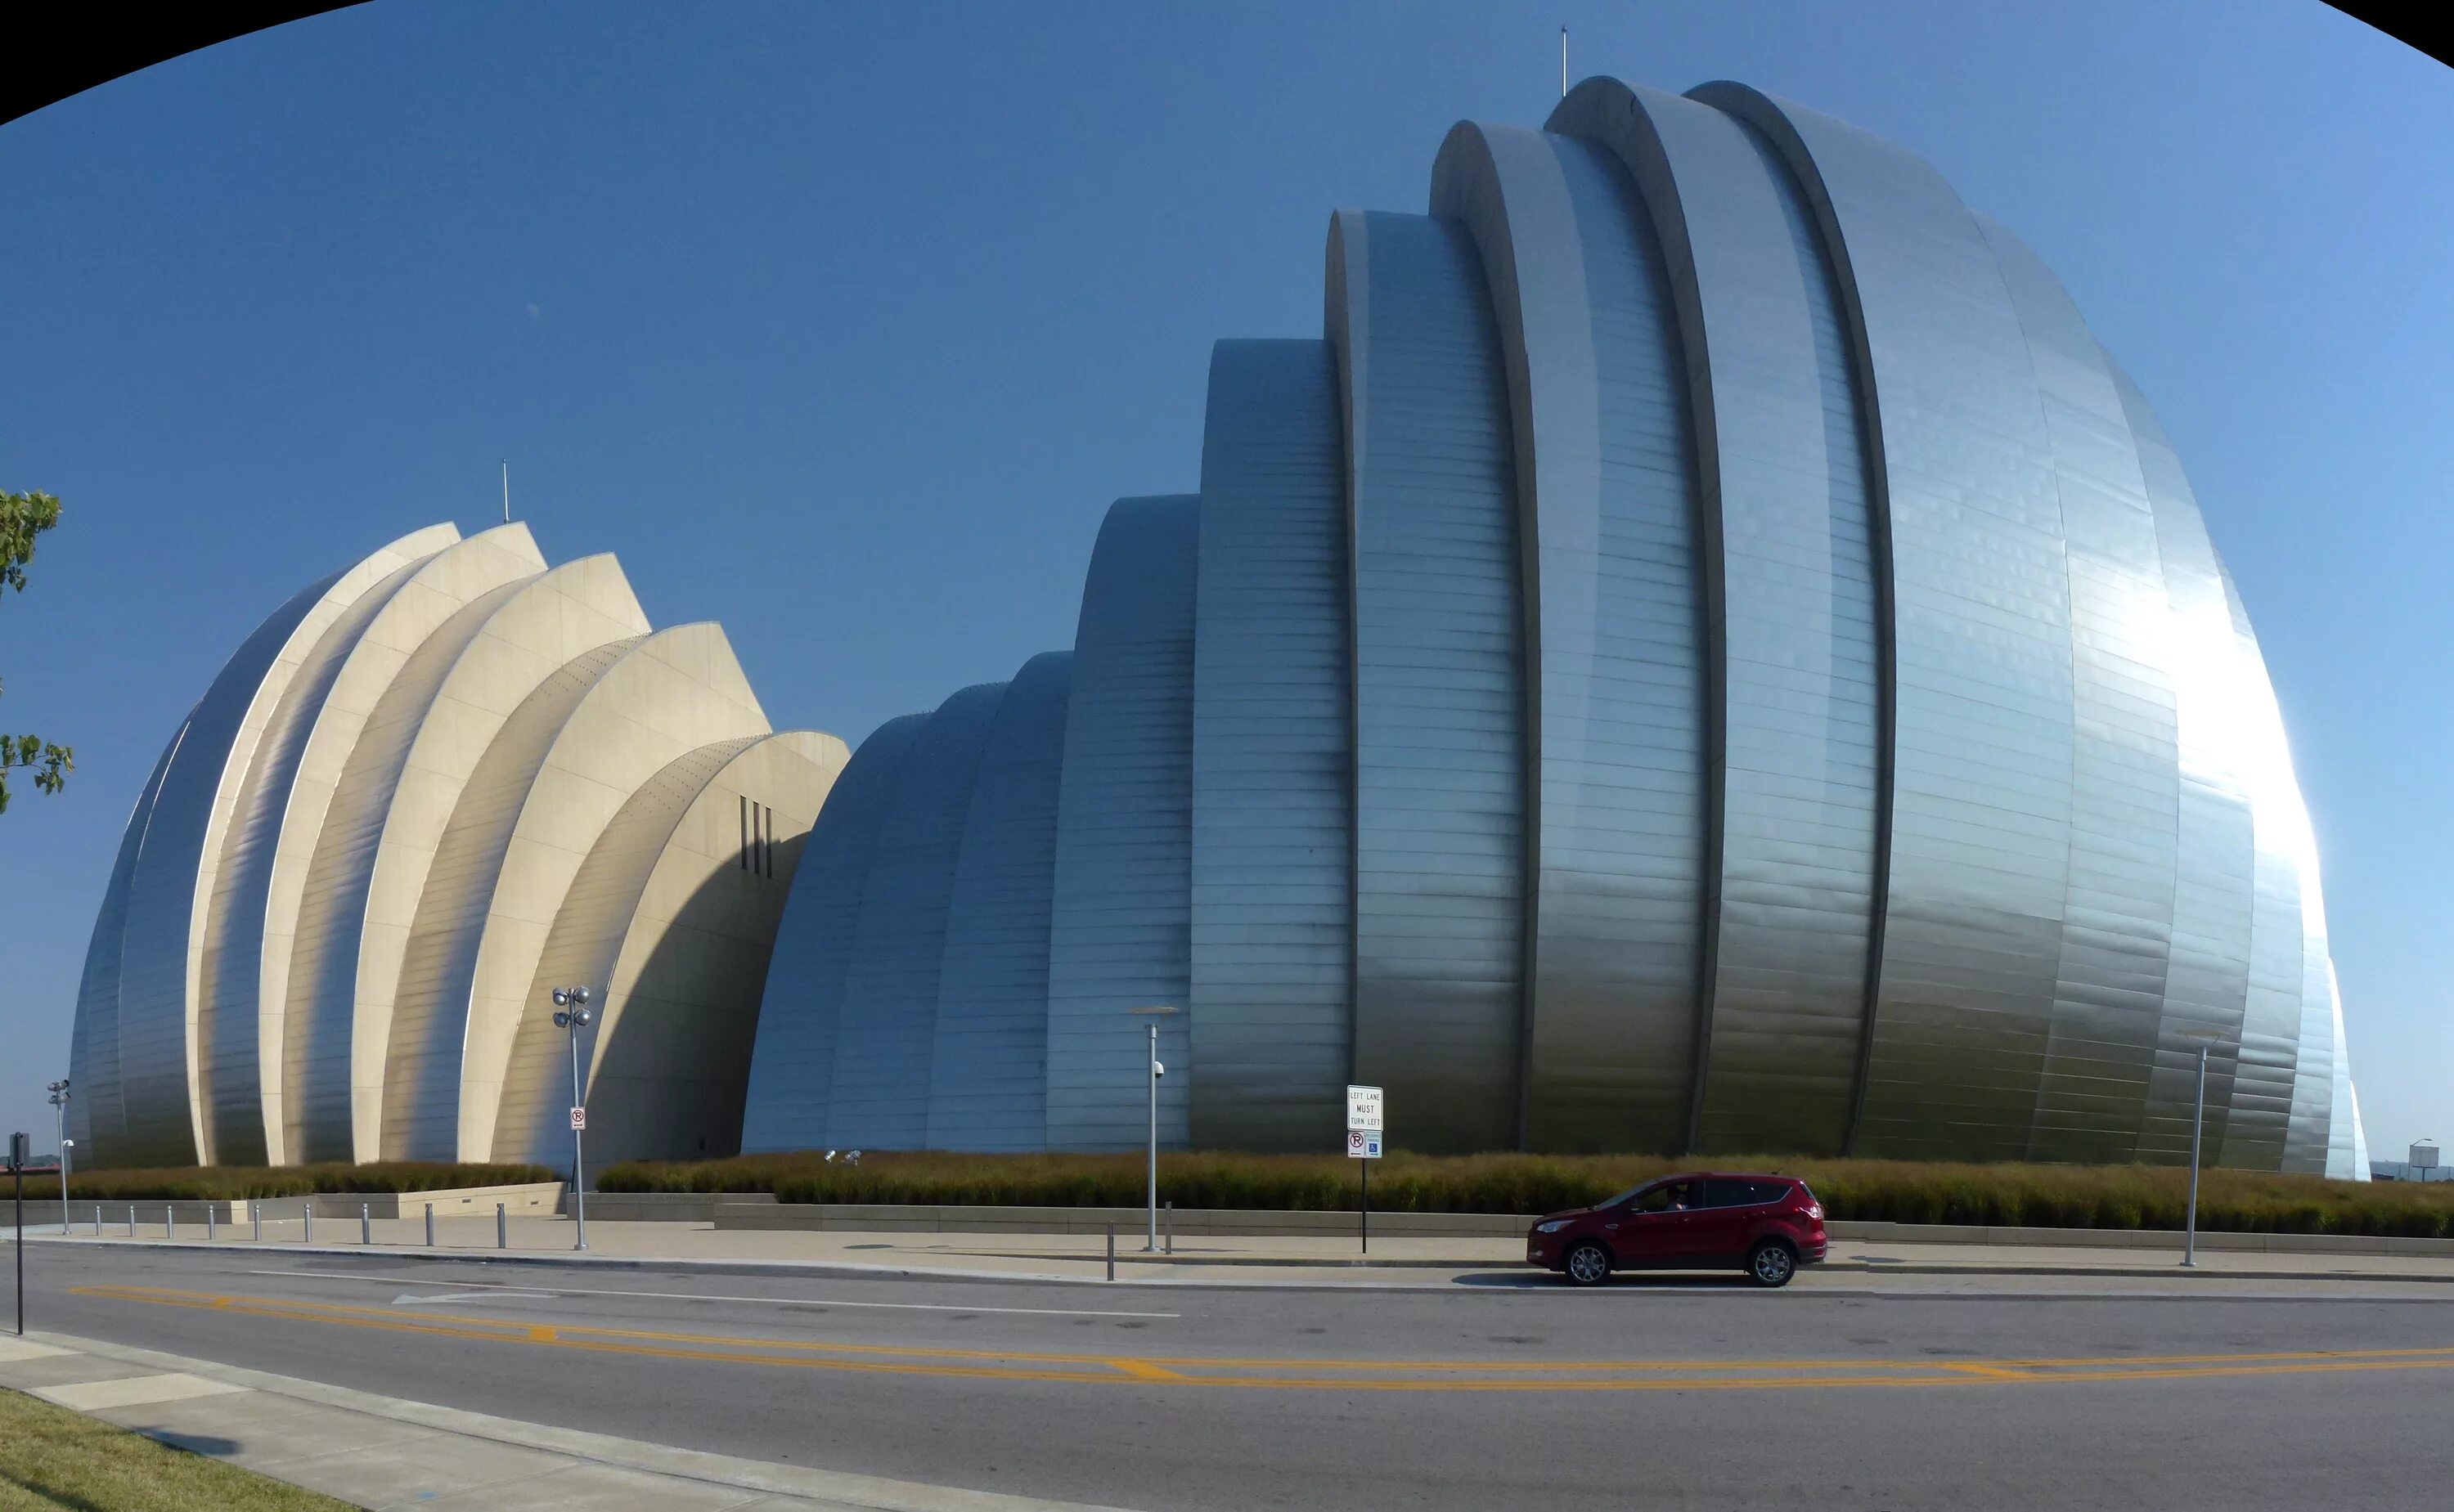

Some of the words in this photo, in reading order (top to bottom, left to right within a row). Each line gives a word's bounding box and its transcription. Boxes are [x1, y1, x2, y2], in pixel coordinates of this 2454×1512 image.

[1351, 1092, 1363, 1100] LEFT
[1356, 1104, 1374, 1114] MUST
[1351, 1117, 1364, 1125] TURN
